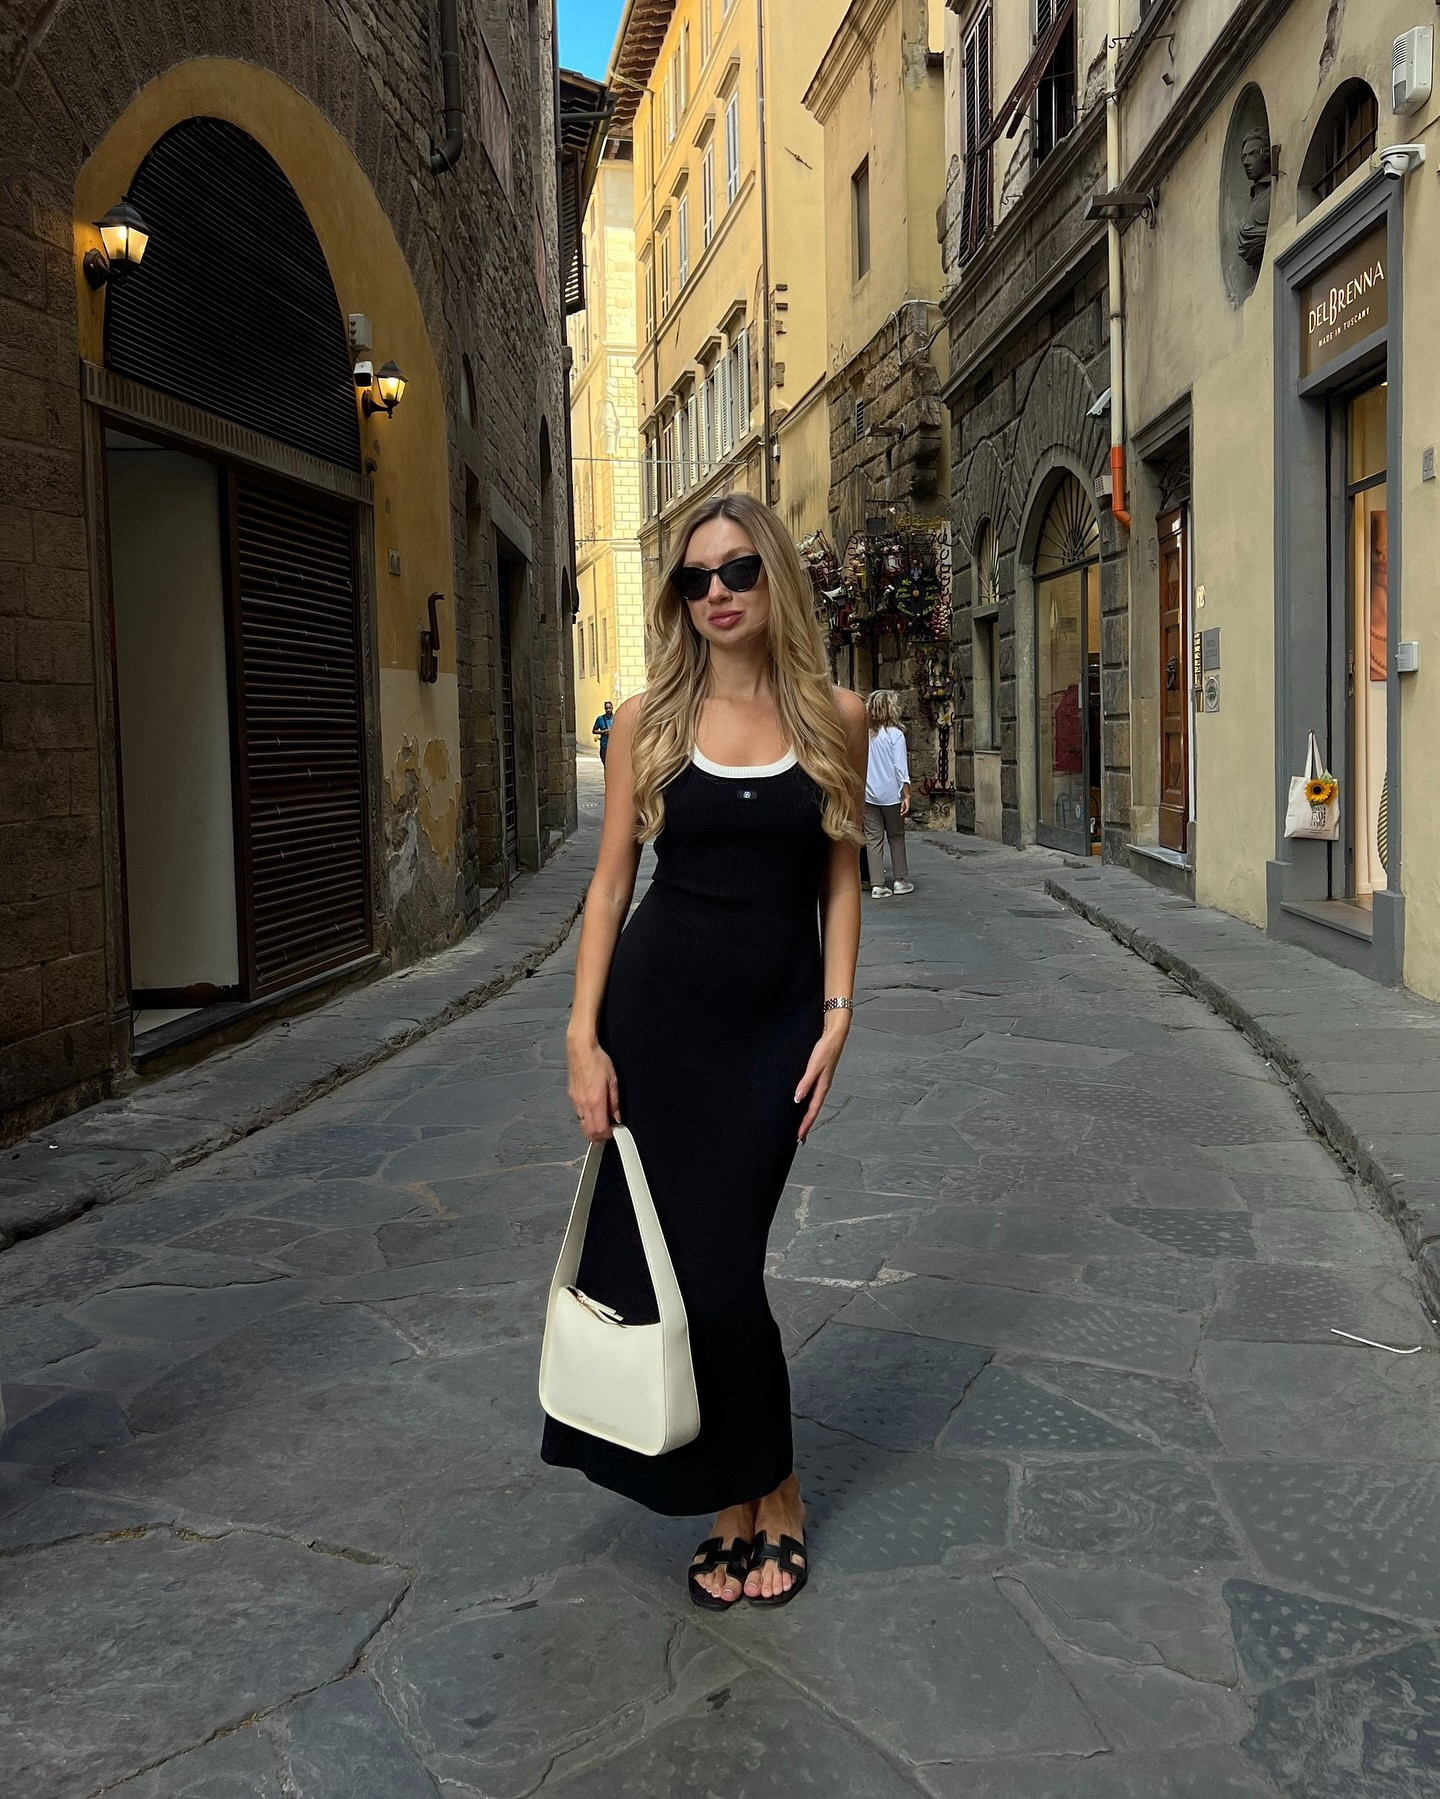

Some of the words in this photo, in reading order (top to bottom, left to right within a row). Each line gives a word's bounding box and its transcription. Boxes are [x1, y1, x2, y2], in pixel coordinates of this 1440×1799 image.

[1318, 332, 1334, 348] MADE
[1335, 327, 1342, 337] IN
[1344, 307, 1370, 331] TUSCANY
